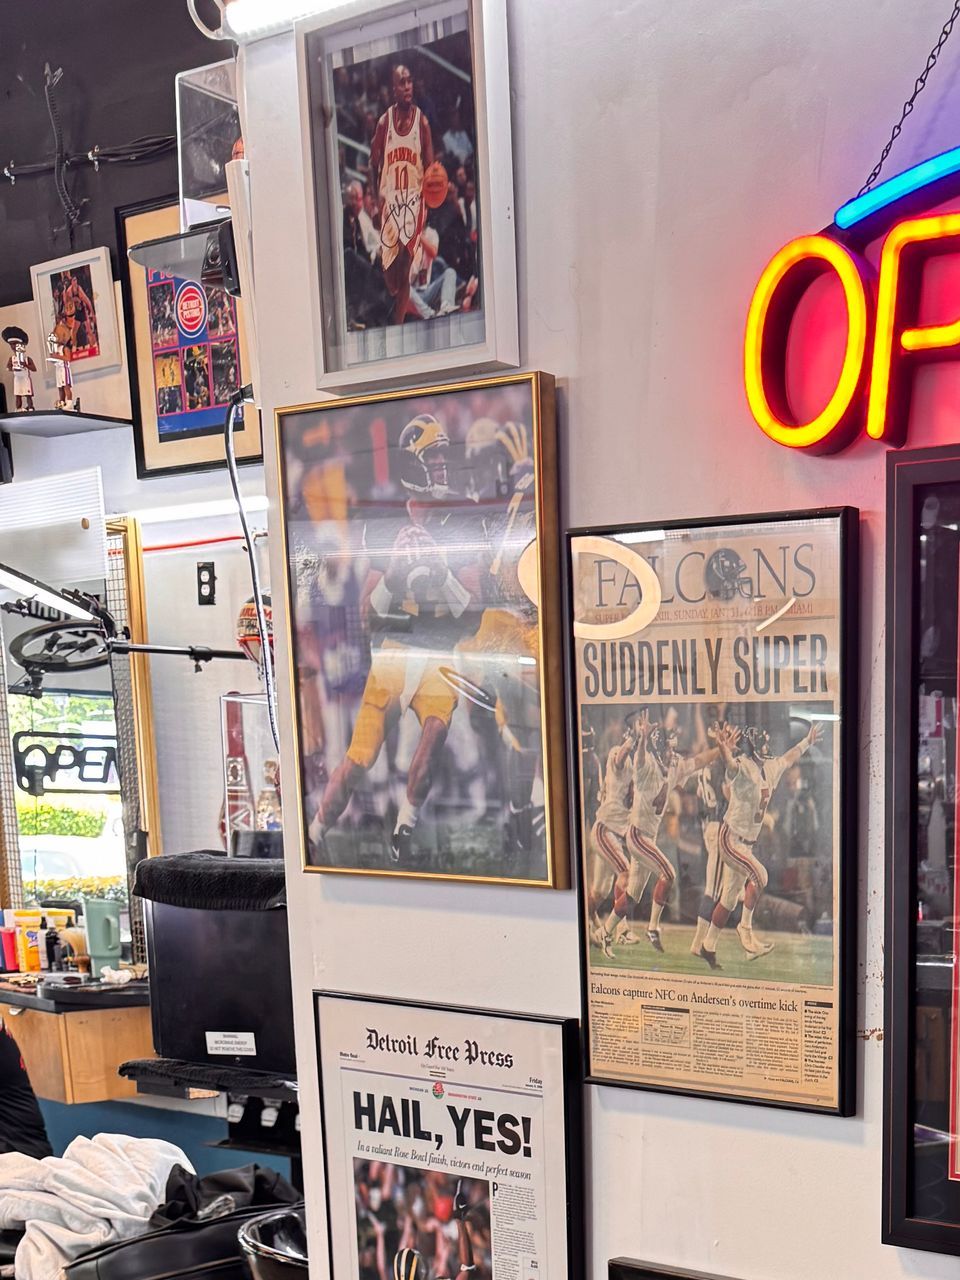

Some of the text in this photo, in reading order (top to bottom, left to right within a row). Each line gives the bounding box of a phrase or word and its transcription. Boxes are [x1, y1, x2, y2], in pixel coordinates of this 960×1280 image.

[387, 147, 417, 166] HAWKS
[583, 634, 828, 698] SUDDENLY SUPER
[590, 982, 621, 996] Falcons
[622, 987, 653, 1000] capture
[655, 988, 676, 1001] NFC
[677, 993, 689, 1002] on
[690, 991, 737, 1007] Andersen's
[739, 997, 777, 1010] overtime
[779, 999, 798, 1012] kick
[366, 1027, 514, 1069] Detroit Free Press
[529, 1076, 543, 1085] Friday
[352, 1091, 532, 1158] HAIL, YES!
[357, 1140, 365, 1152] In
[371, 1143, 393, 1156] valiant
[394, 1146, 409, 1159] Rose
[411, 1149, 428, 1162] Bowl
[428, 1152, 449, 1169] finish,
[450, 1156, 471, 1170] victors
[471, 1160, 485, 1172] end
[485, 1163, 508, 1178] perfect
[509, 1170, 532, 1181] season
[492, 1181, 499, 1197] P
